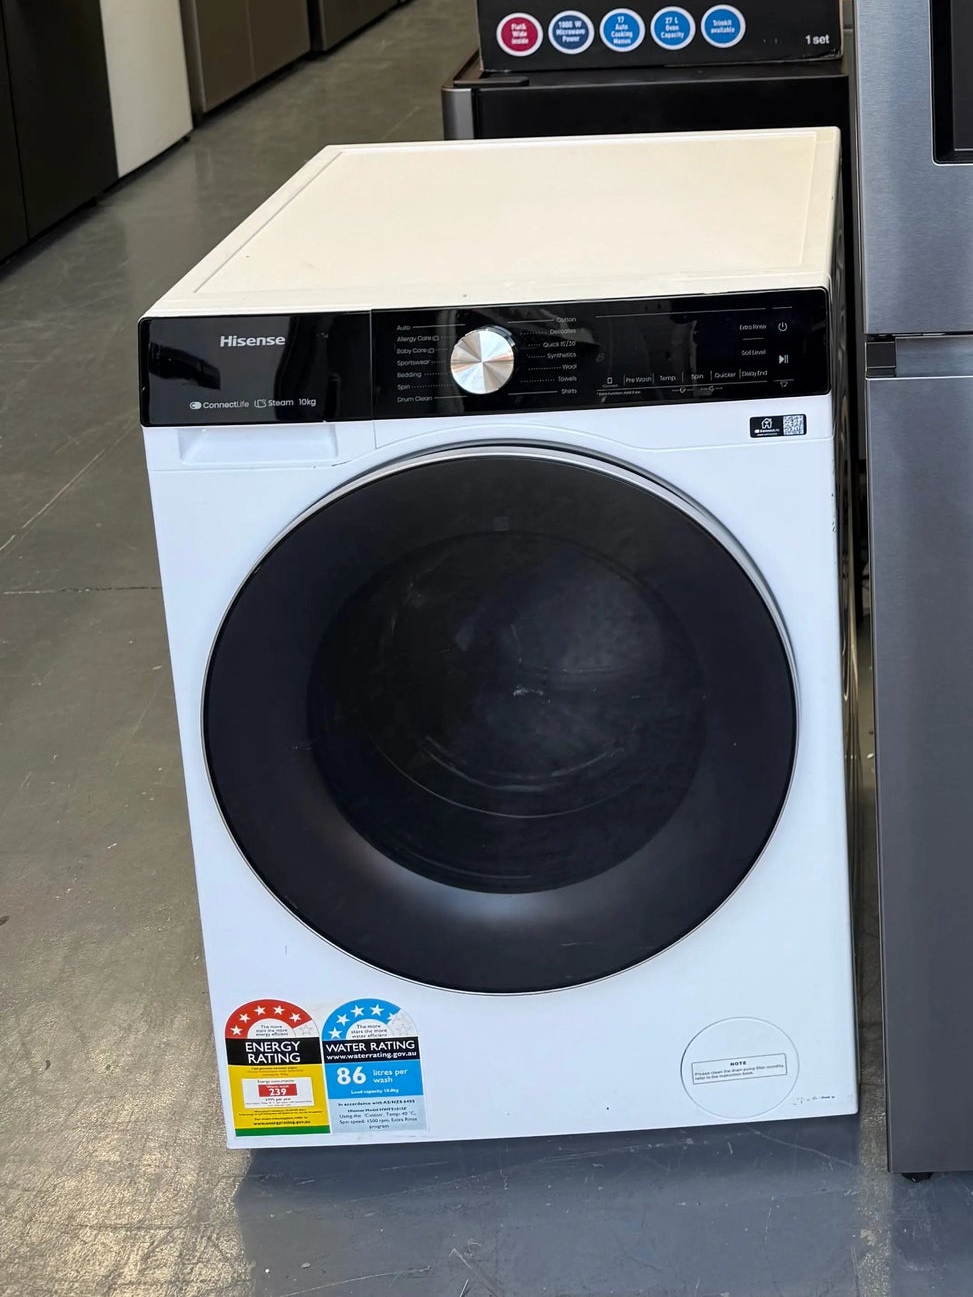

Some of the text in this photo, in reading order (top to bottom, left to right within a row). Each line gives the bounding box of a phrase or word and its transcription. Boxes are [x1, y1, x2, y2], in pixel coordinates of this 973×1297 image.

[660, 31, 684, 39] Capacity
[710, 26, 735, 34] available
[805, 34, 830, 45] 1 set
[220, 335, 286, 347] Hisense
[203, 398, 316, 409] ConnectLife Steam 10kg
[245, 1041, 300, 1052] ENERGY
[325, 1040, 415, 1053] WATER RATING
[248, 1053, 300, 1064] RATING
[326, 1051, 417, 1060] www.waterrating.gov.au
[336, 1066, 367, 1085] 86
[269, 1088, 287, 1096] 239
